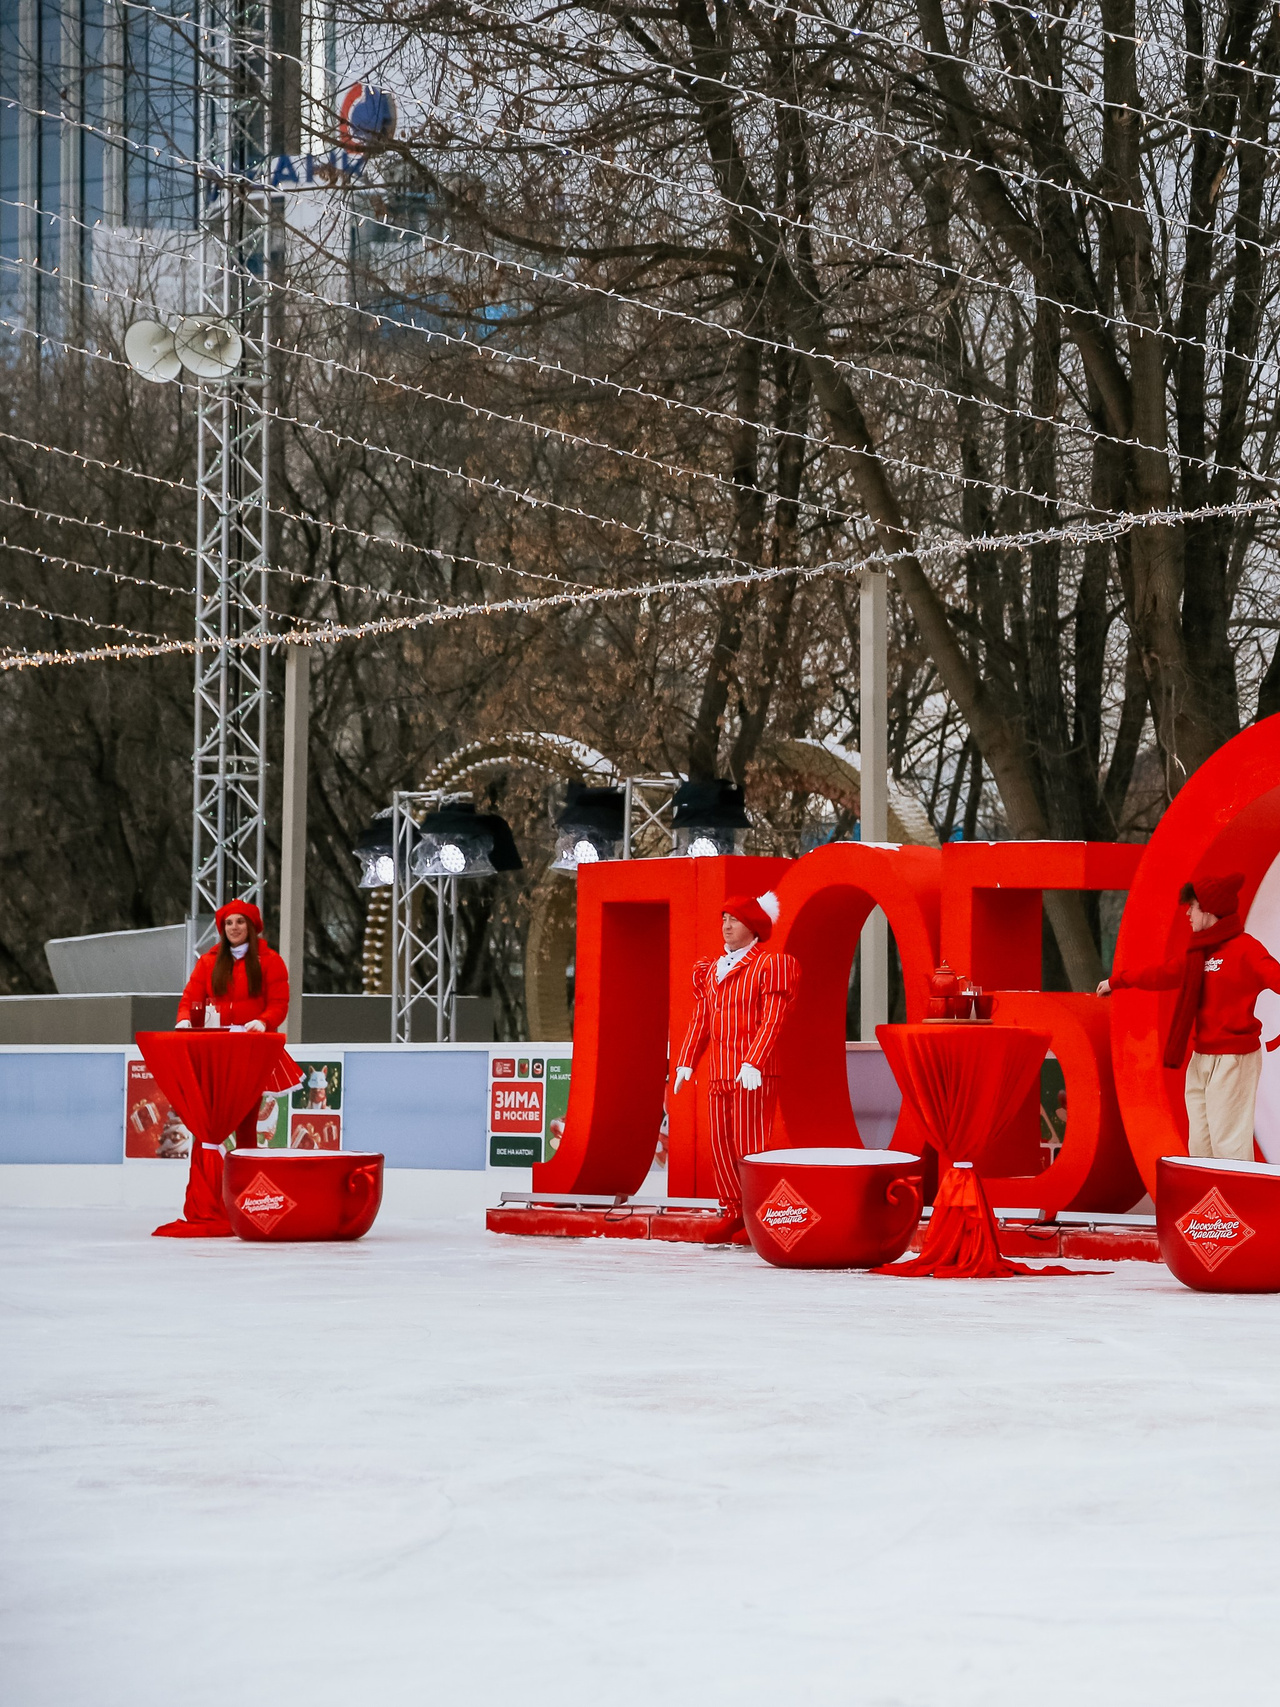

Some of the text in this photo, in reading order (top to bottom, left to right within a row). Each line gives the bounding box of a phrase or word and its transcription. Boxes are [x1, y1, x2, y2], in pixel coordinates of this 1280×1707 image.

[549, 1065, 561, 1073] ВСЕ
[494, 1090, 541, 1109] ЗИМА
[494, 1110, 540, 1121] В МОСКВЕ
